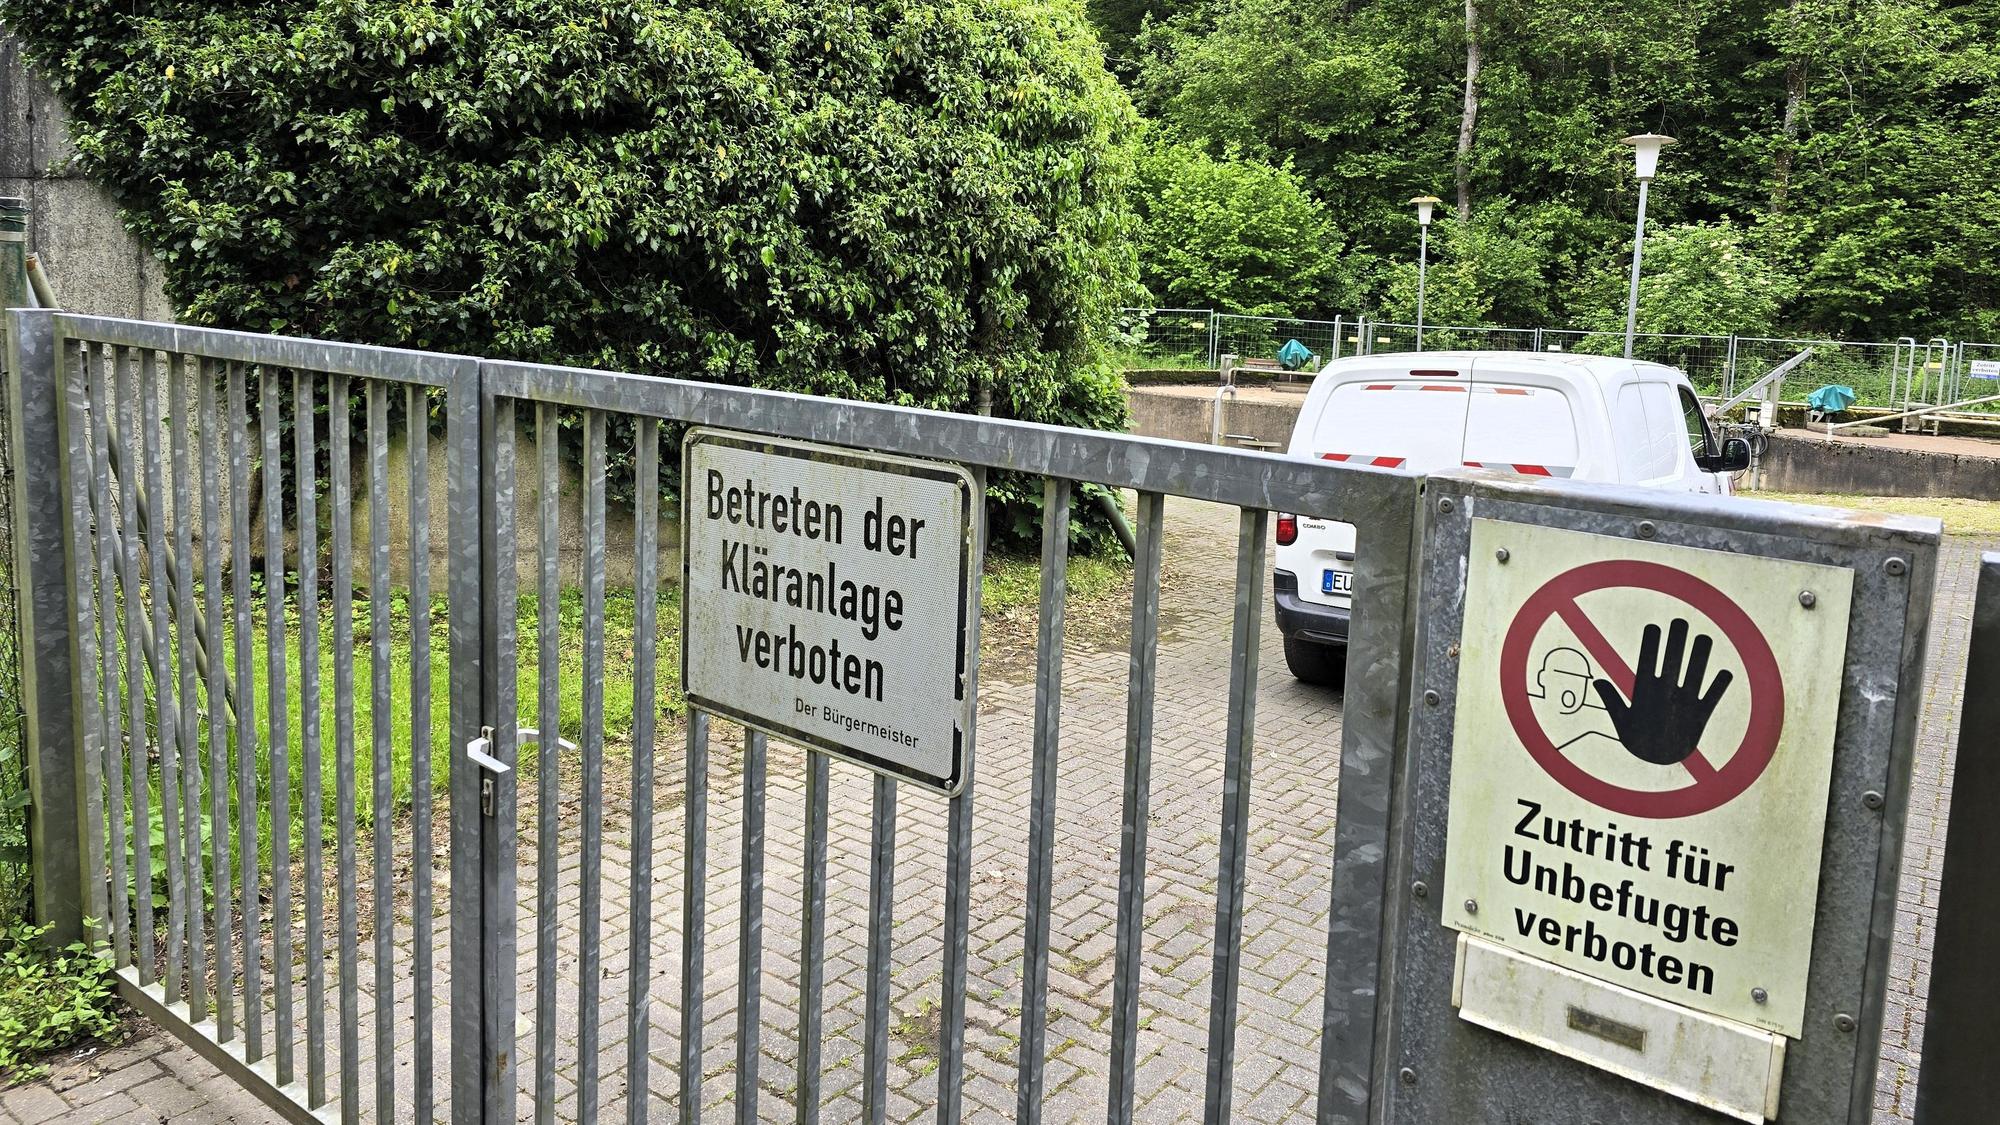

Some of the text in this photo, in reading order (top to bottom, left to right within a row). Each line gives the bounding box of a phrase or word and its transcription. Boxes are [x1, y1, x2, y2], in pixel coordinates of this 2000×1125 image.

[706, 468, 926, 560] Betreten der
[721, 538, 904, 641] Kläranlage
[735, 624, 884, 701] verboten
[795, 698, 919, 749] Der Bürgermeister
[1514, 798, 1735, 892] Zutritt für
[1503, 844, 1739, 947] Unbefugte
[1514, 907, 1715, 996] verboten
